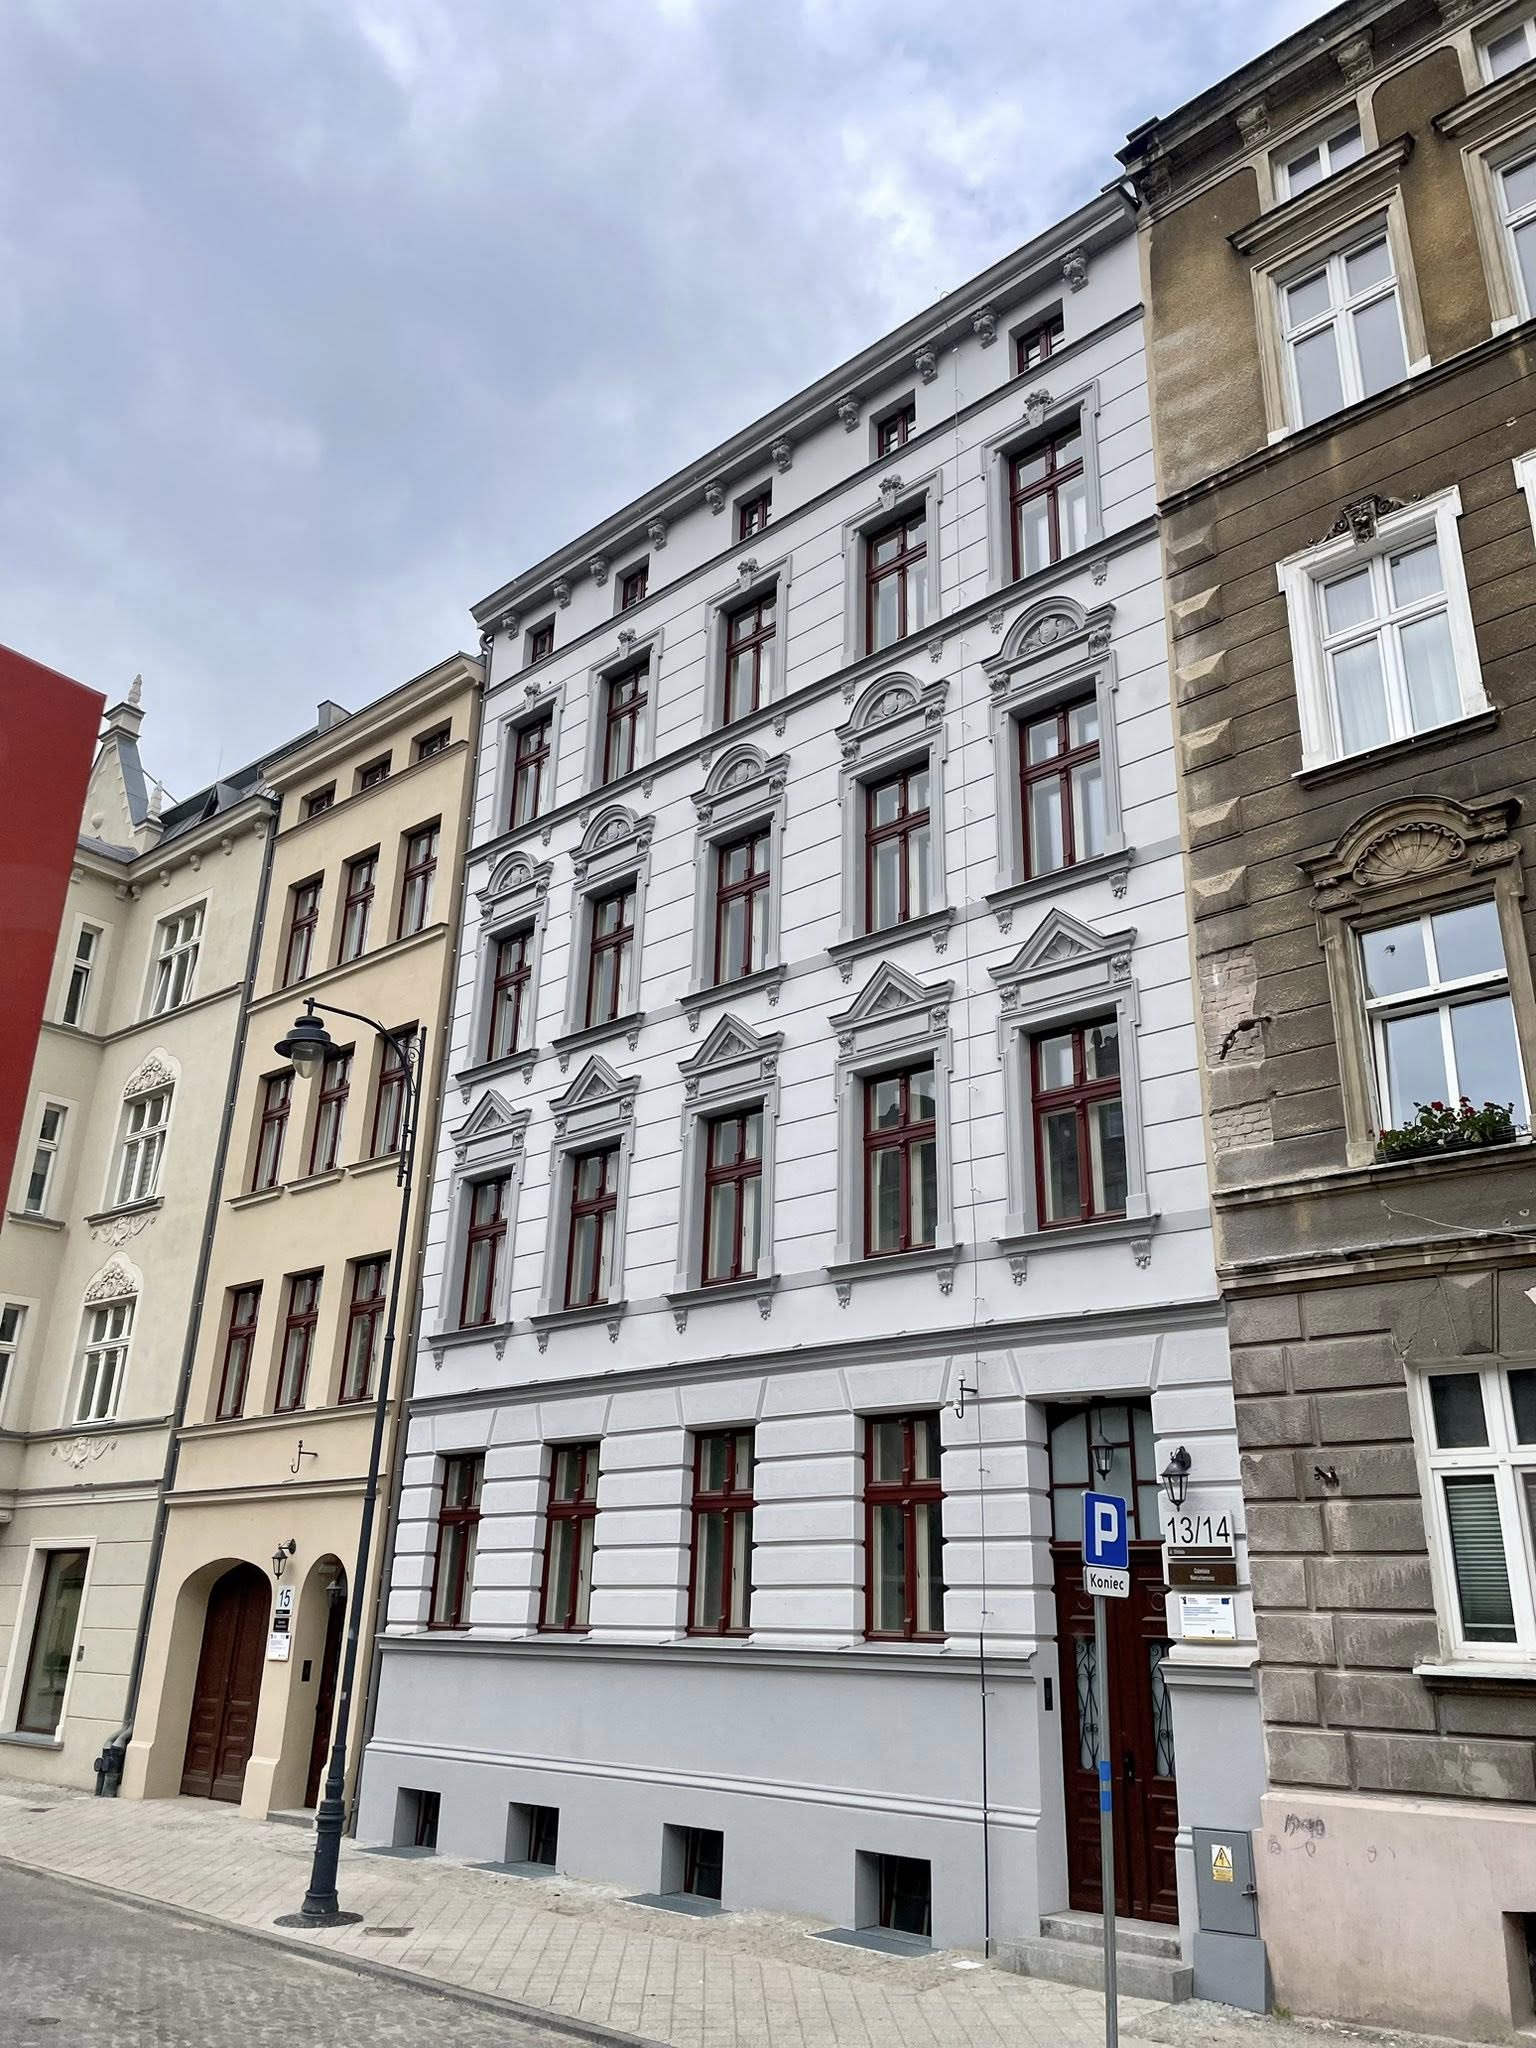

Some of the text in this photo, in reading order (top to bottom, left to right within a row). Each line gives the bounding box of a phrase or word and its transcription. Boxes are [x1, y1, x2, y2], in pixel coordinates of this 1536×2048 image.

[1167, 1515, 1230, 1544] 13/14
[1090, 1573, 1124, 1591] Koniec
[279, 1589, 291, 1608] 15
